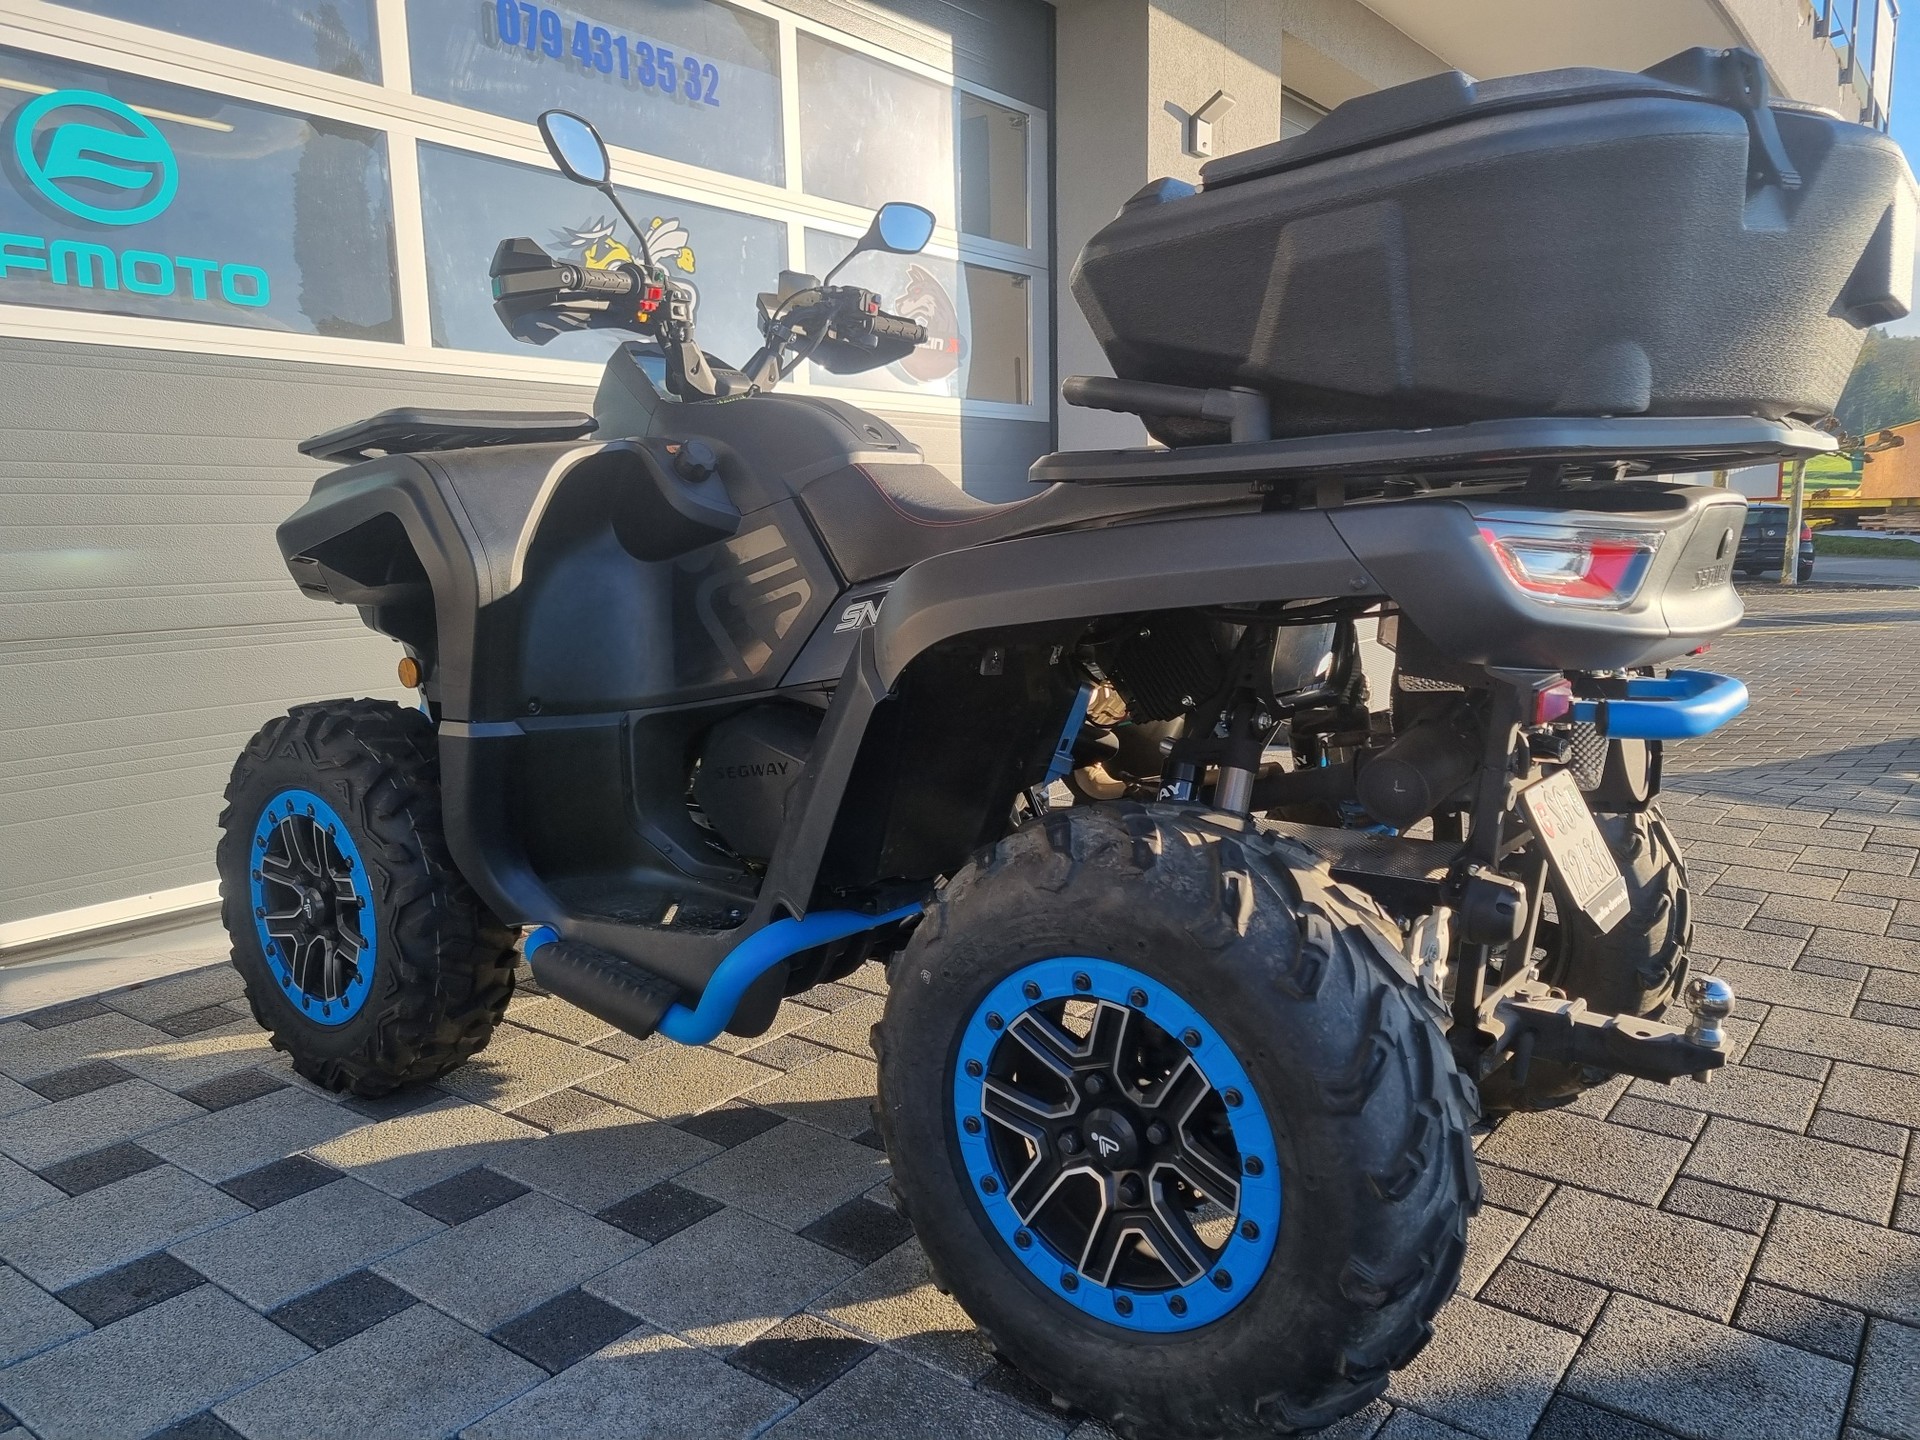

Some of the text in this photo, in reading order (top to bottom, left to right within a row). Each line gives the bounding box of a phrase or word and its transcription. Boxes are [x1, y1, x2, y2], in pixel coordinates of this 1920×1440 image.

[497, 0, 720, 107] 079 431 35 32
[0, 232, 271, 307] FMOTO
[717, 761, 788, 779] SEGWAY
[1544, 785, 1577, 835] SG
[1561, 831, 1613, 902] 12436
